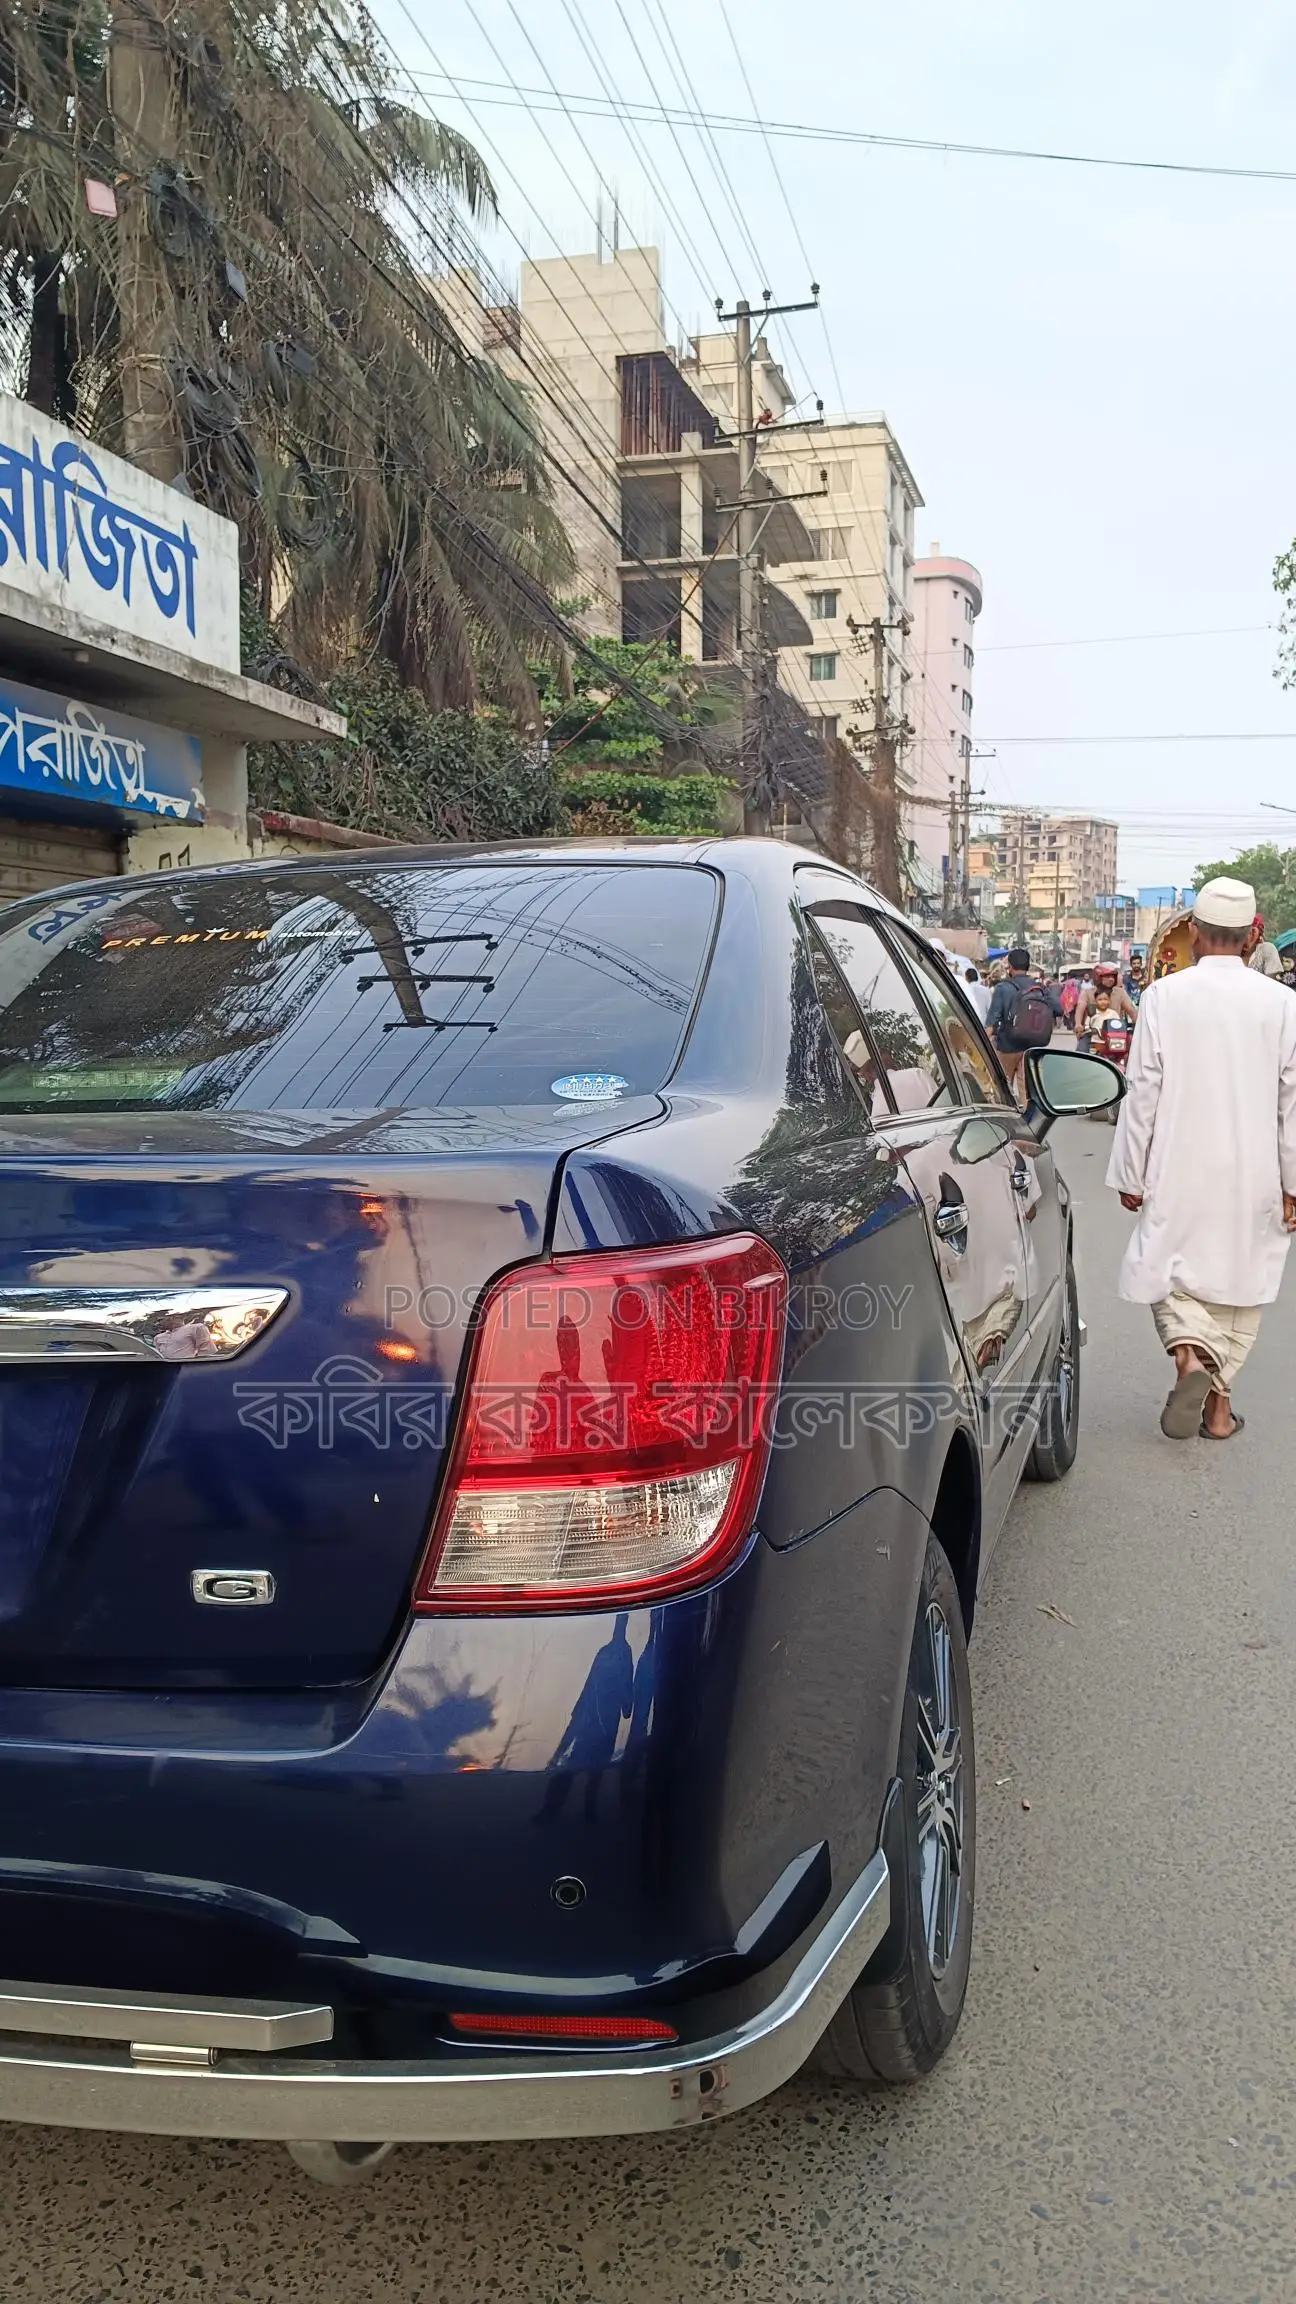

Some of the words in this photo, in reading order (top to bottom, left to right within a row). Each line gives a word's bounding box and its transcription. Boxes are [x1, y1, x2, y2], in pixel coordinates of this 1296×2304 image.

[101, 929, 271, 950] PREMIUM
[278, 929, 361, 938] automobile
[203, 1577, 258, 1602] G
